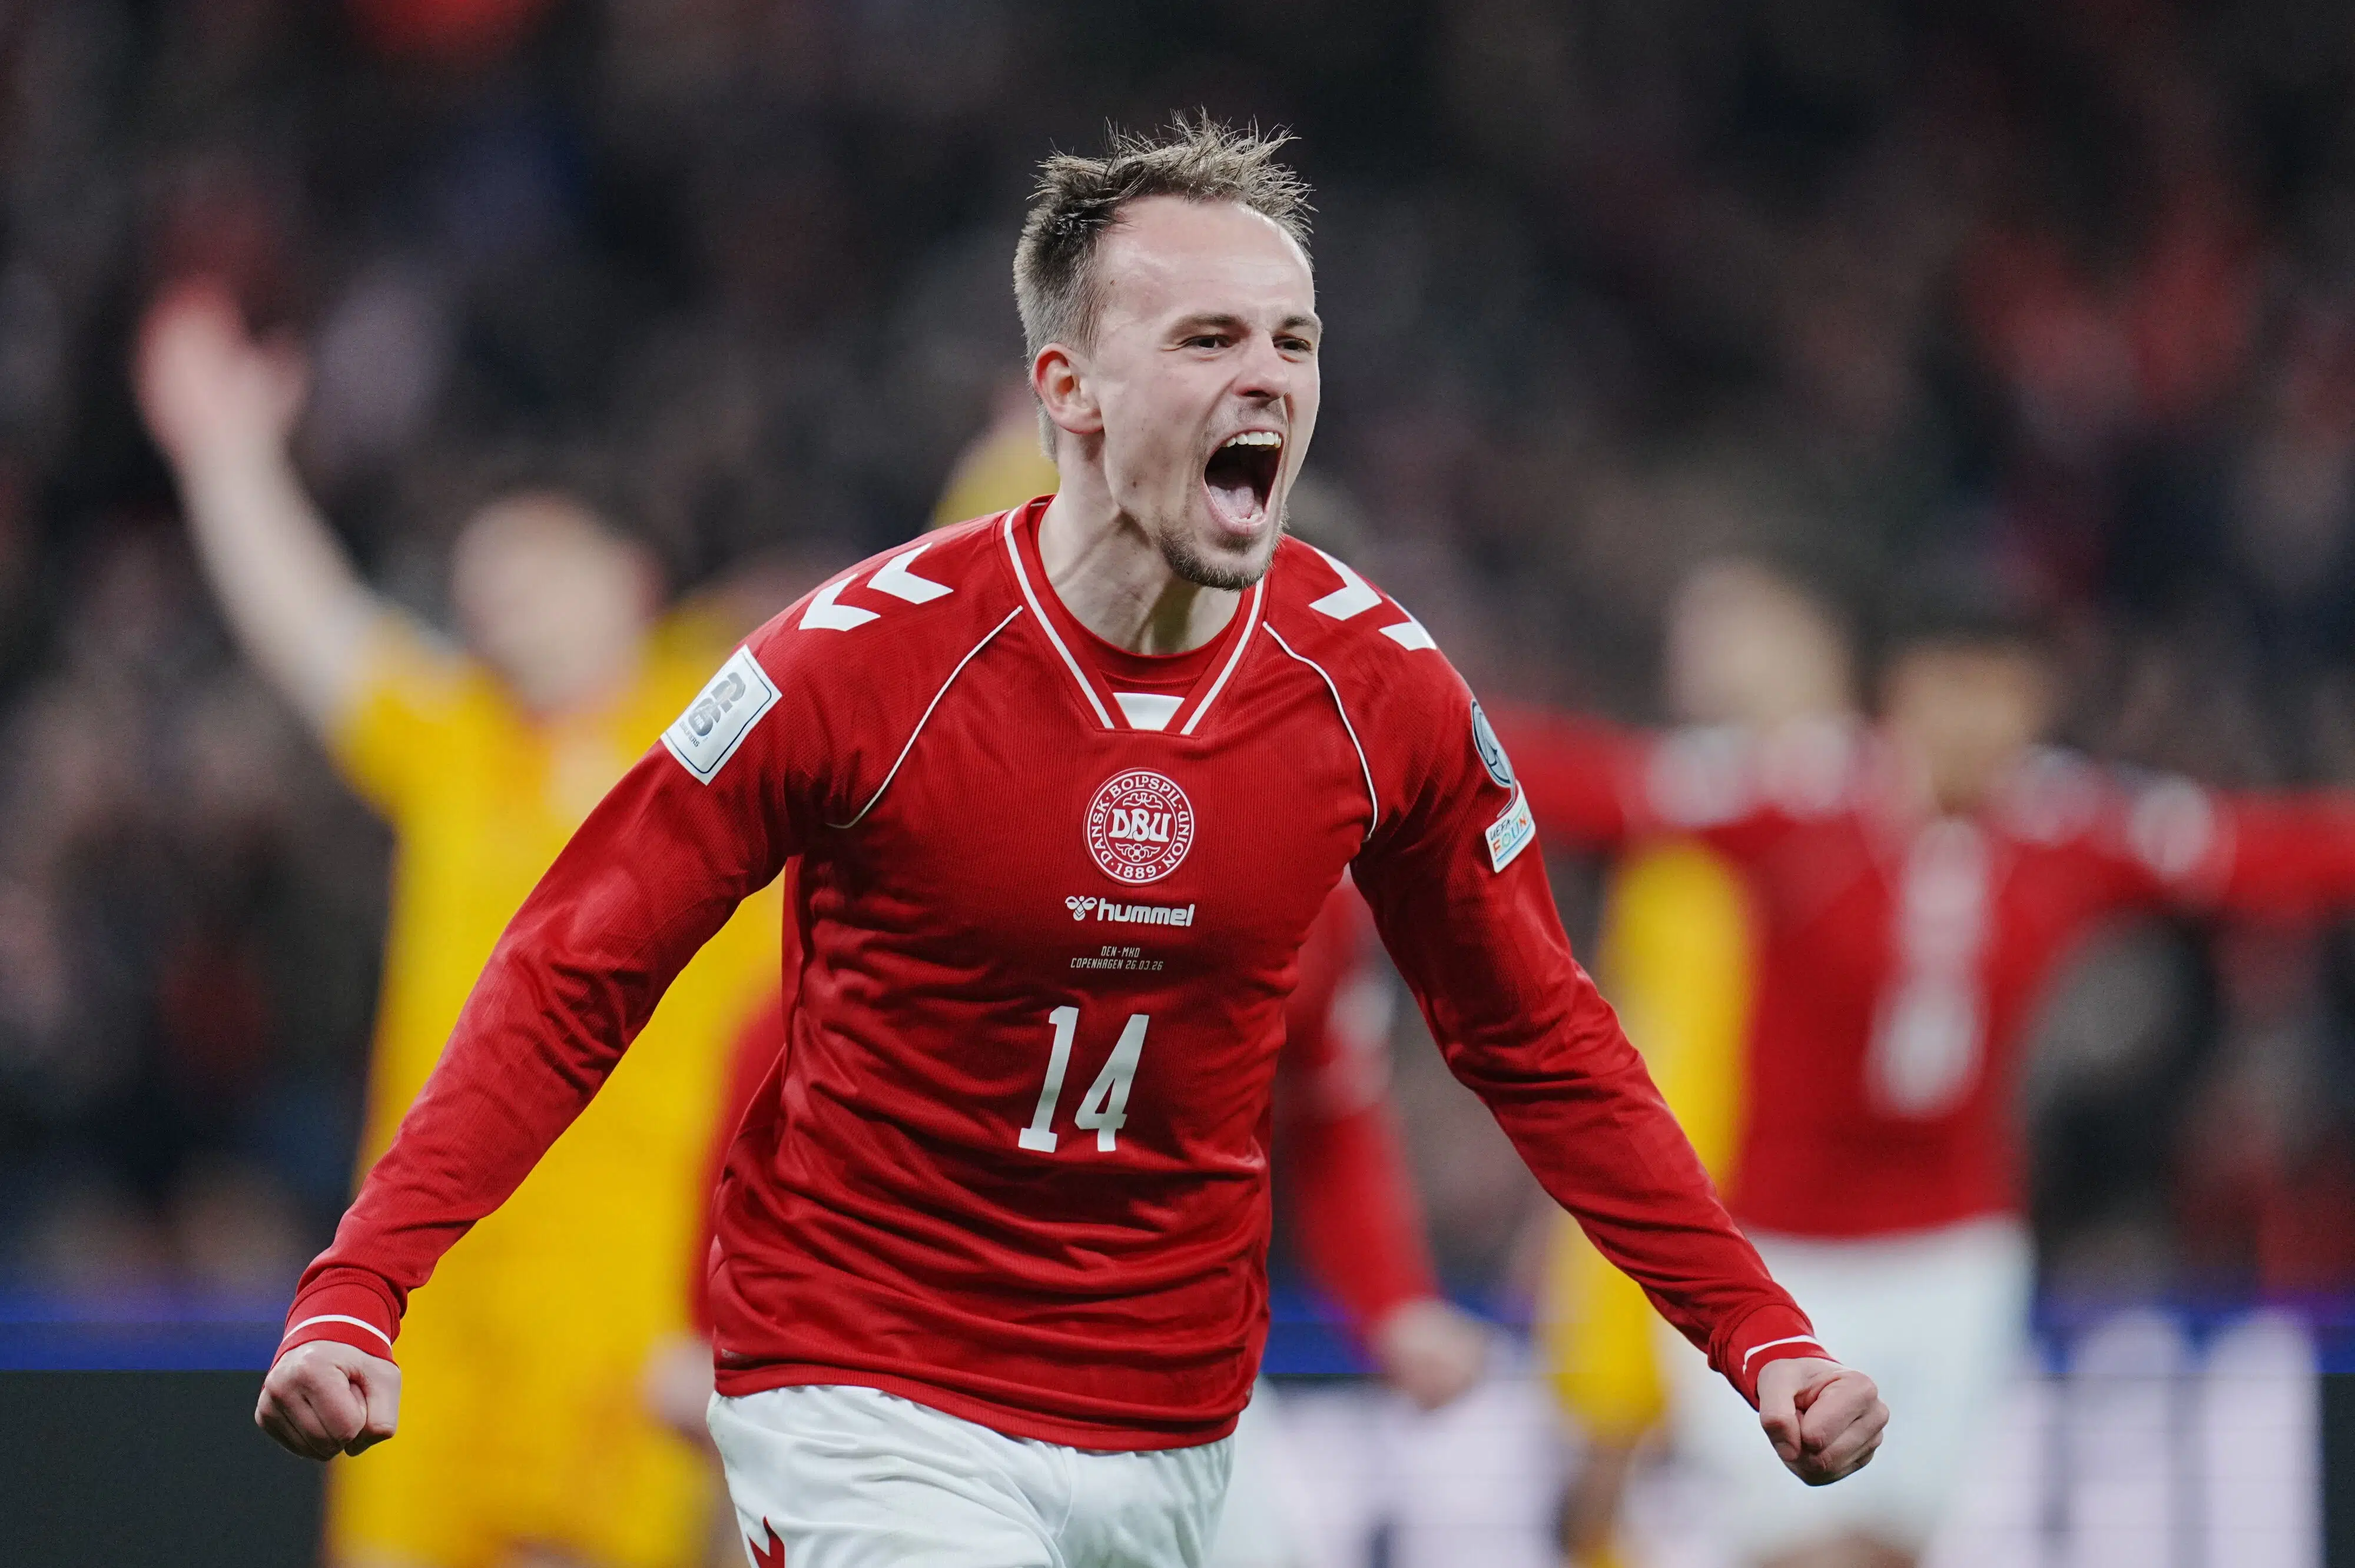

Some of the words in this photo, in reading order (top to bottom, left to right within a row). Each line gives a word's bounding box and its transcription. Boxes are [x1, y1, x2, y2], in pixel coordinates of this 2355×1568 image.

[1092, 799, 1113, 865] DANSK
[1114, 862, 1157, 879] 1889
[1108, 808, 1172, 842] DBU
[1490, 818, 1511, 841] UEFA
[1097, 897, 1196, 927] hummel
[1070, 957, 1124, 969] COPENHAGEN
[1125, 959, 1164, 971] 26.03.26
[1017, 1005, 1150, 1153] 14
